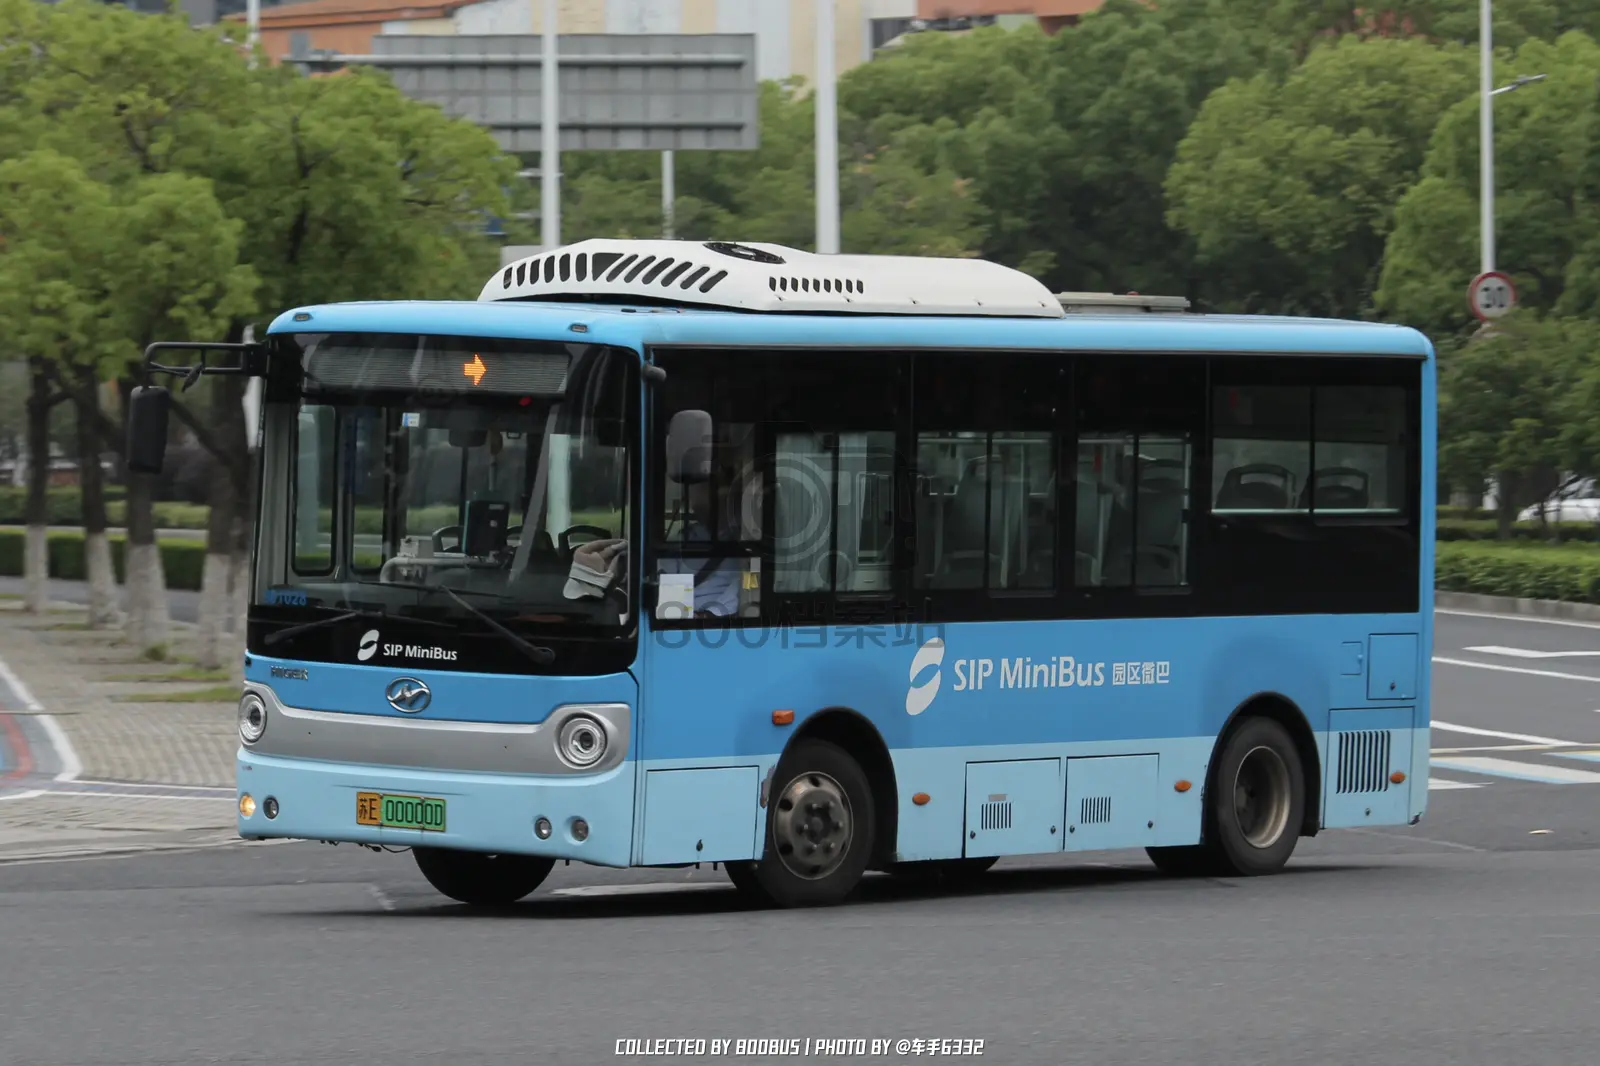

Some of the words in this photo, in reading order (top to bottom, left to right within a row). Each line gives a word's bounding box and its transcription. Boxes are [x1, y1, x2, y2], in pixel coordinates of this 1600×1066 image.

[383, 643, 403, 657] SIP
[404, 645, 458, 661] MiniBus
[953, 658, 994, 691] SIP
[1000, 656, 1106, 689] MiniBus
[1112, 661, 1171, 686] 园区微巴
